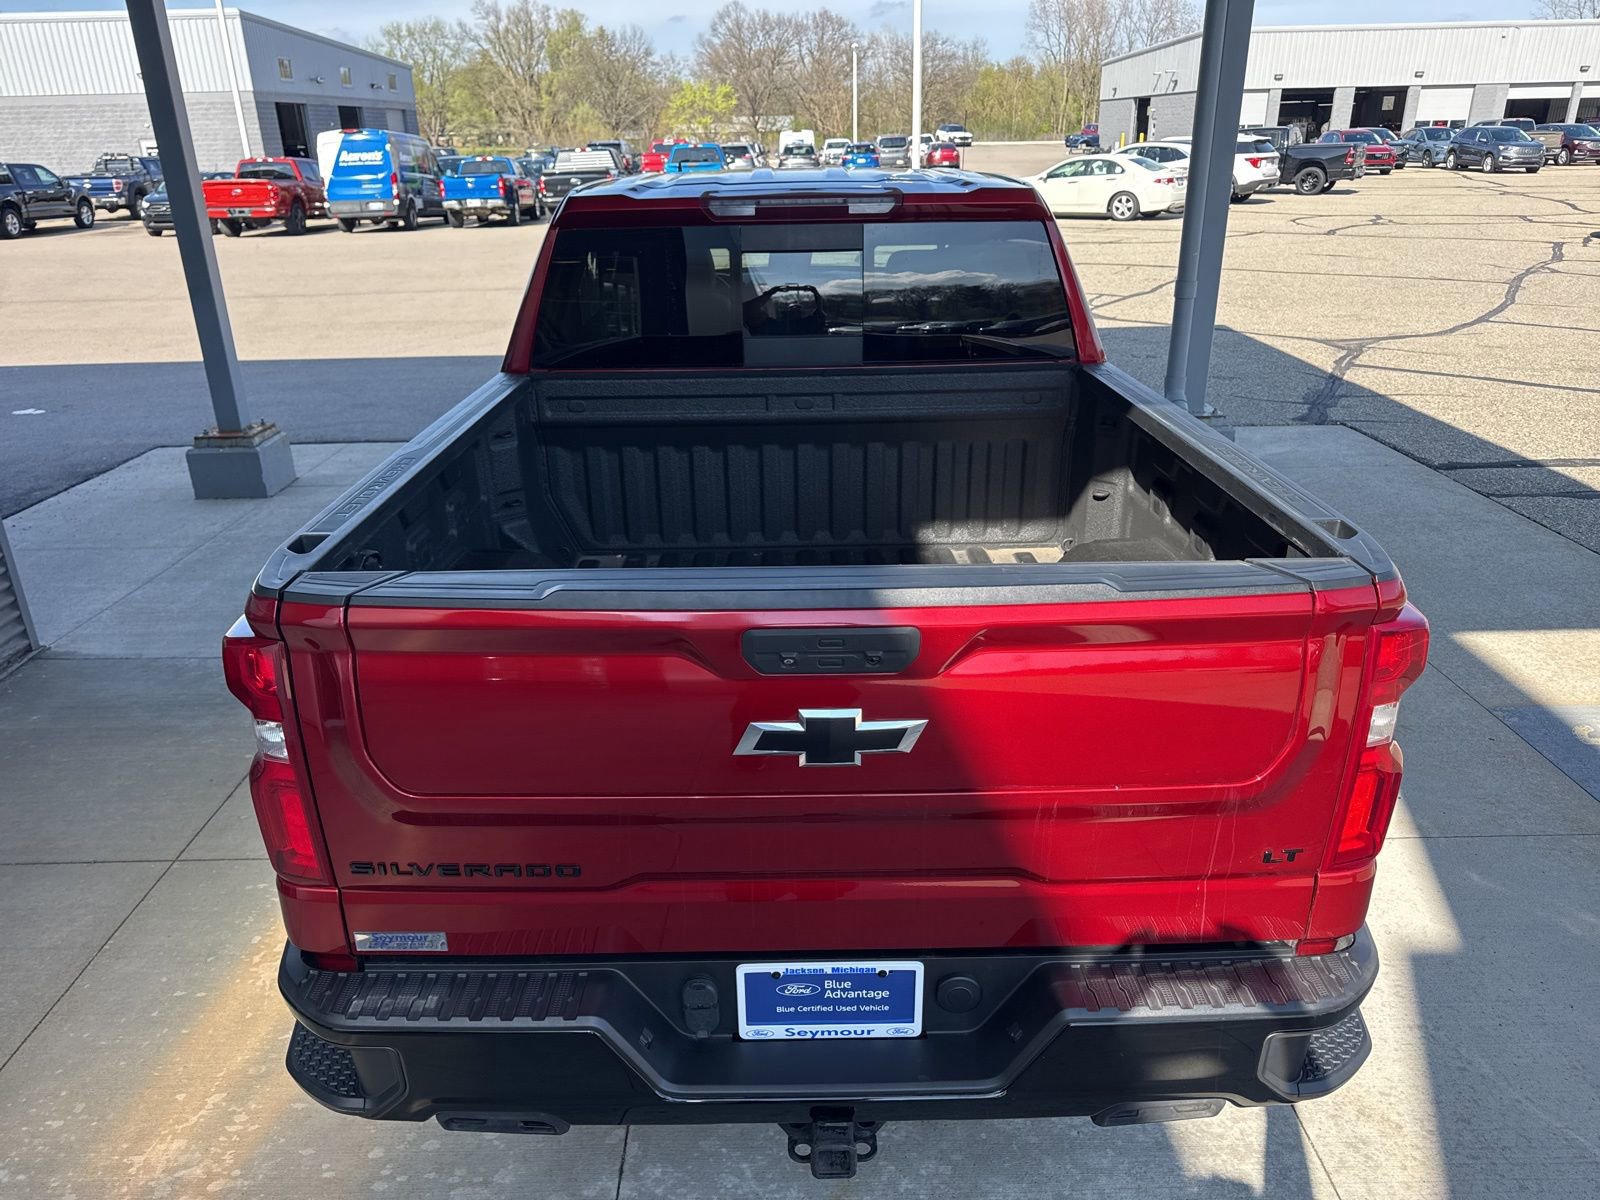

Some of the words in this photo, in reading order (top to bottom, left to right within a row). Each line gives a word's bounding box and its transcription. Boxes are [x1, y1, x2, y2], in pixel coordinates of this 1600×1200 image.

[336, 457, 416, 518] CHEVROLET
[1262, 848, 1304, 863] LT
[350, 861, 582, 878] SILVERADO
[783, 967, 828, 975] Jackson,
[831, 966, 877, 974] Michigan
[784, 984, 812, 996] Ford
[824, 980, 852, 989] Blue
[824, 989, 890, 1000] Advantage
[835, 1004, 857, 1012] Used
[859, 1004, 890, 1012] Vehicle
[784, 1027, 876, 1040] Seymour
